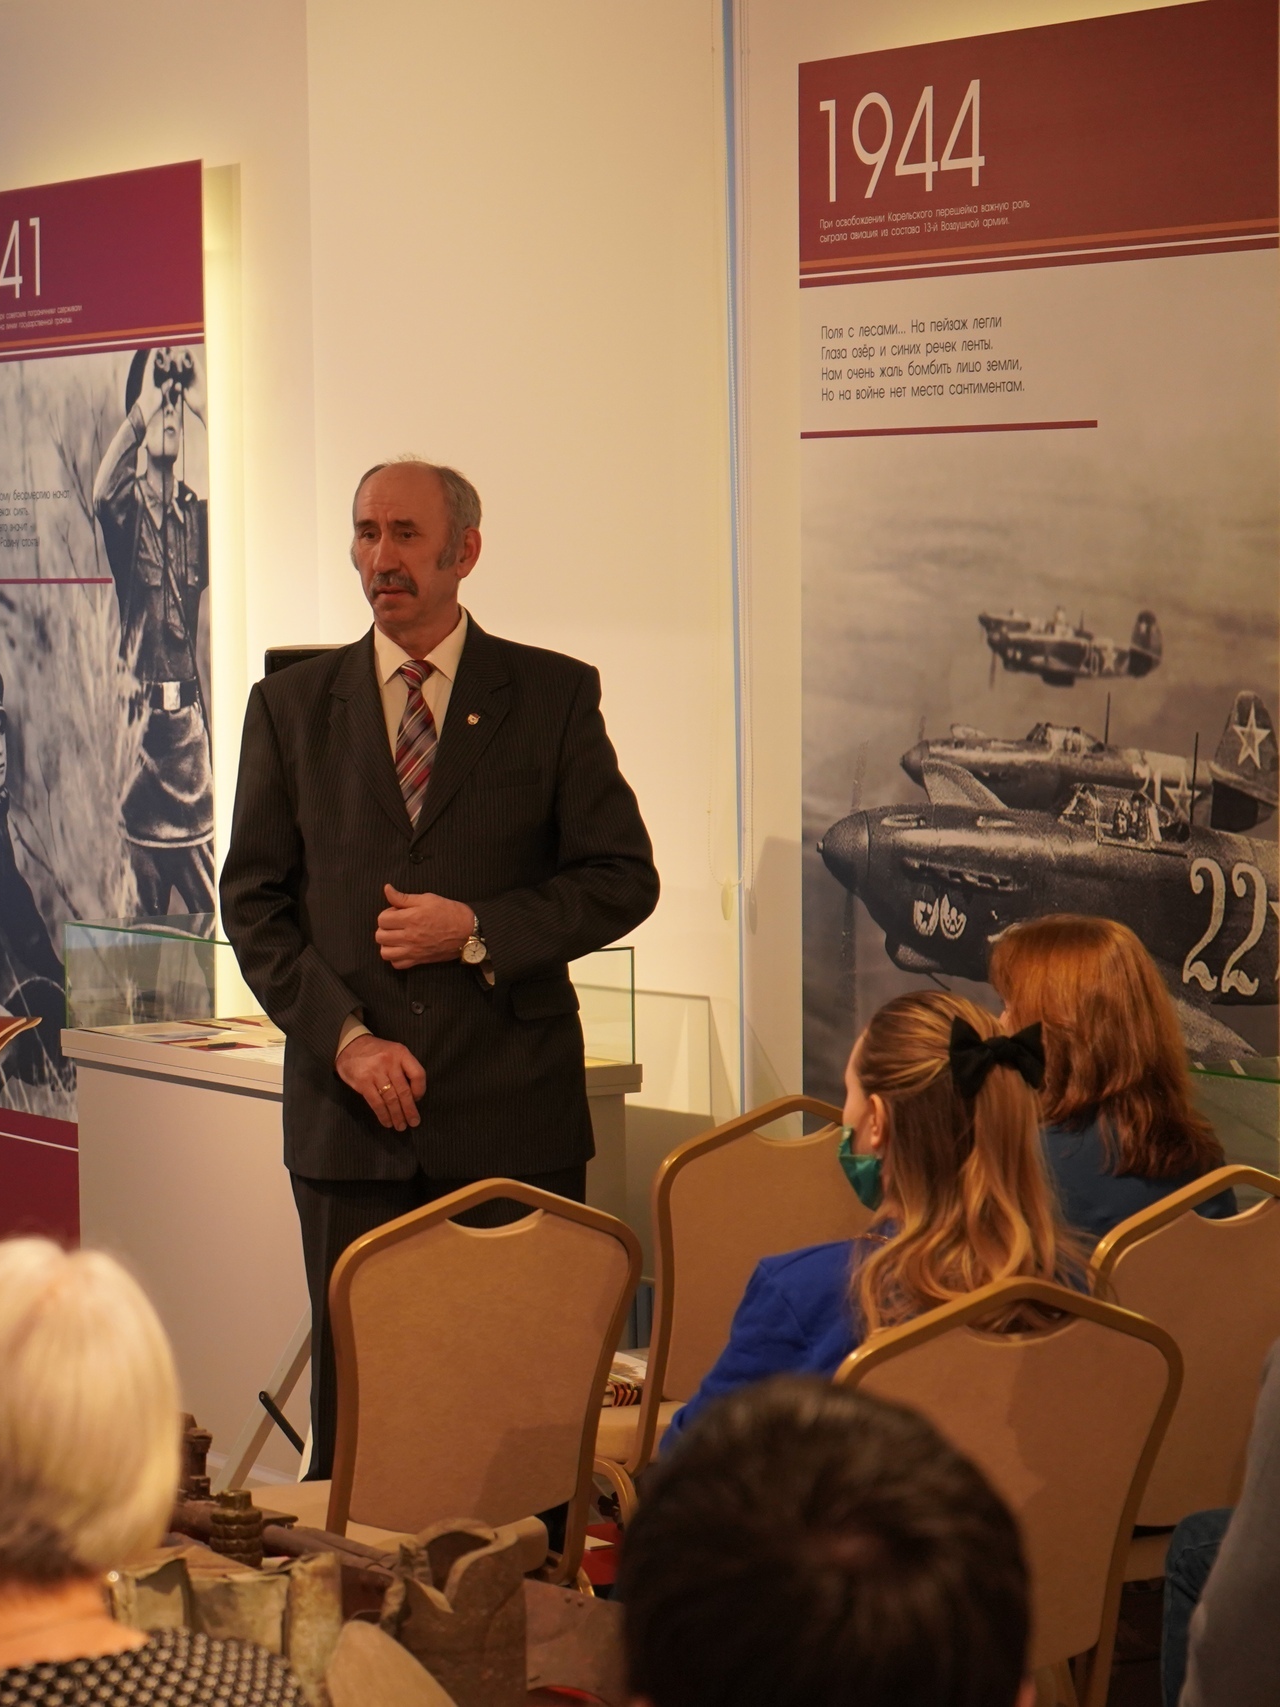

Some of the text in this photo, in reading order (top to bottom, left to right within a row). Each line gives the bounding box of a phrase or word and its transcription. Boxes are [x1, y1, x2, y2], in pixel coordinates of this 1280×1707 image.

[819, 78, 986, 203] 1944
[820, 200, 1030, 230] При освобождении Карельского перешейка важную роль
[820, 231, 848, 244] сыграла
[850, 227, 878, 240] авиация
[881, 227, 889, 237] из
[891, 225, 920, 236] состава
[924, 221, 938, 233] 13-й
[941, 218, 980, 232] Воздушной
[821, 316, 1002, 340] Поля с лесами... На пейзаж легли
[821, 339, 993, 360] Глаза озёр и синих речек ленты.
[821, 358, 1023, 381] Нам очень жаль бомбить лицо земли,
[821, 380, 1025, 401] Но на войне нет места сантиментам.
[1182, 857, 1268, 996] 22
